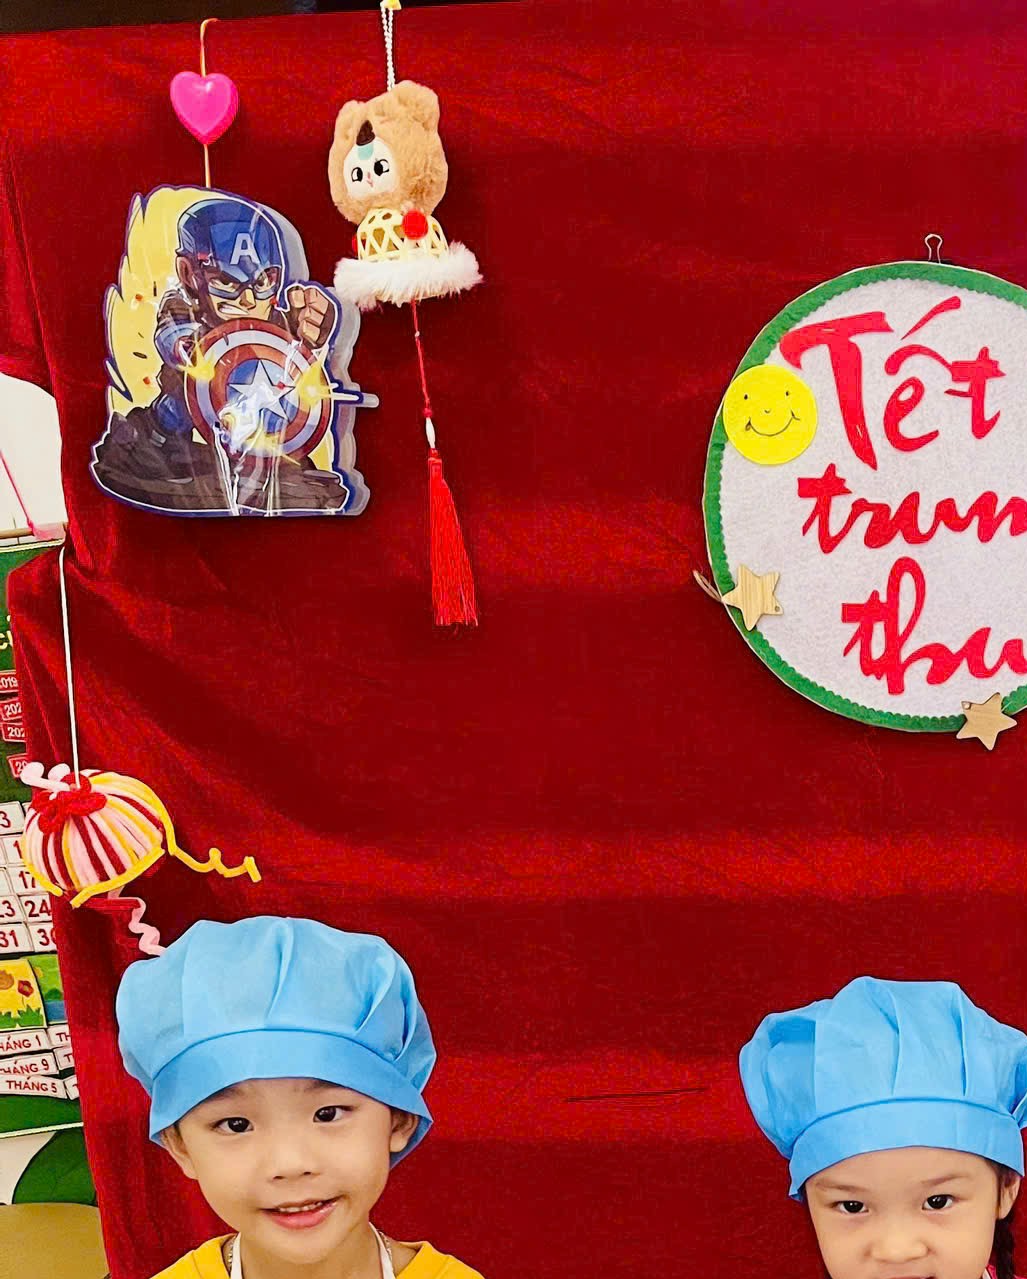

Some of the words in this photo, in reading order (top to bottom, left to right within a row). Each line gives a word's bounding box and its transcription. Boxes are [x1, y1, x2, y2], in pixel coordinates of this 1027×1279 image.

[230, 233, 259, 265] A
[779, 296, 1006, 470] Tết
[0, 676, 19, 689] 019
[4, 702, 22, 717] 202
[24, 899, 51, 918] 24
[0, 1034, 32, 1051] HÁNG
[41, 1058, 50, 1071] 9
[6, 1075, 49, 1092] THÁNG
[50, 1082, 58, 1093] 5
